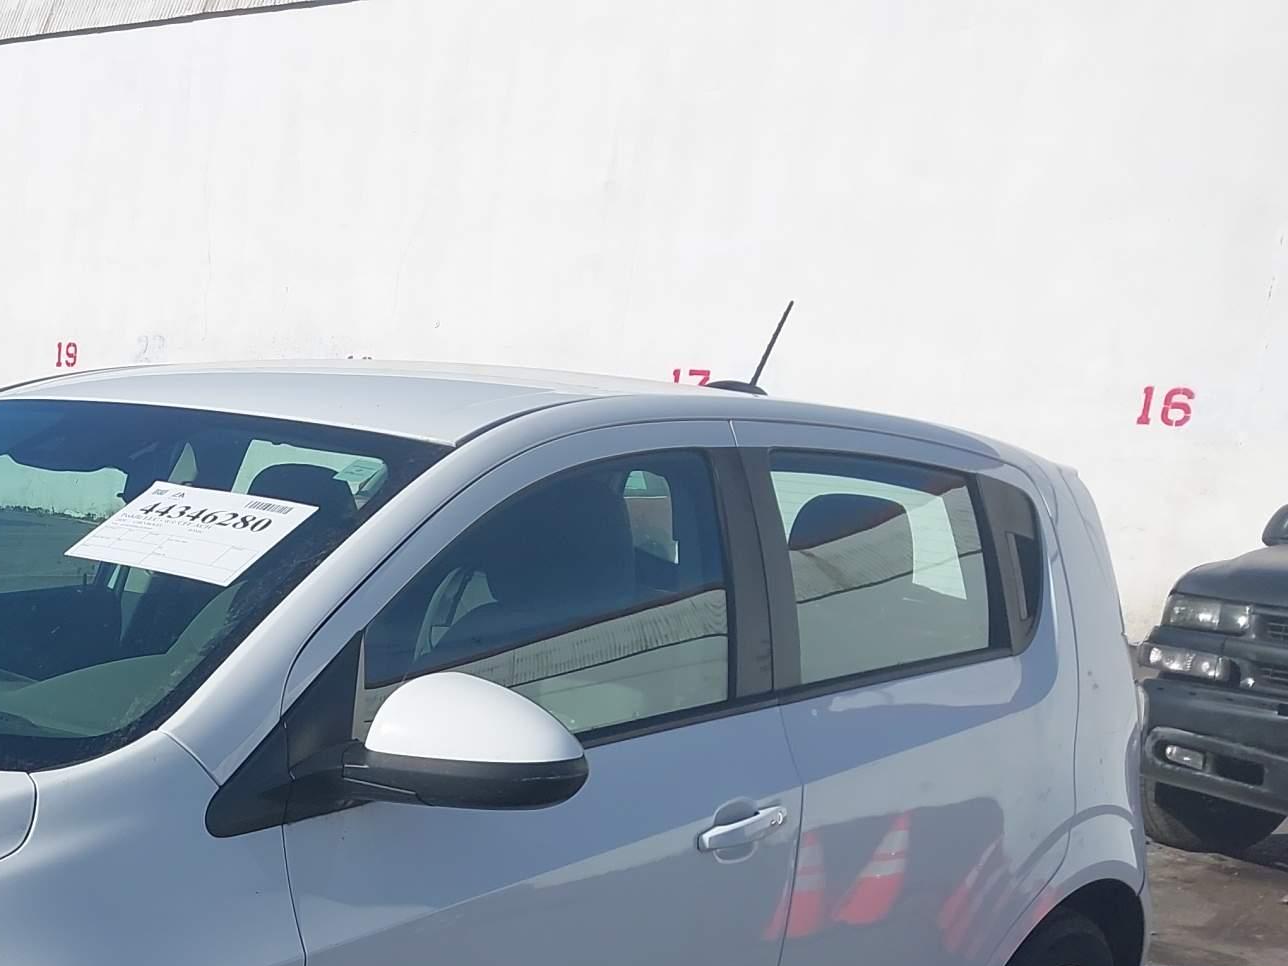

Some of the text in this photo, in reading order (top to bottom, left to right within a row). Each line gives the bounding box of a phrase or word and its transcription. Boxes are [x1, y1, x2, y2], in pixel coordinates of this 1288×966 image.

[55, 341, 78, 368] 19
[1136, 385, 1195, 427] 16
[139, 501, 273, 533] 44346280
